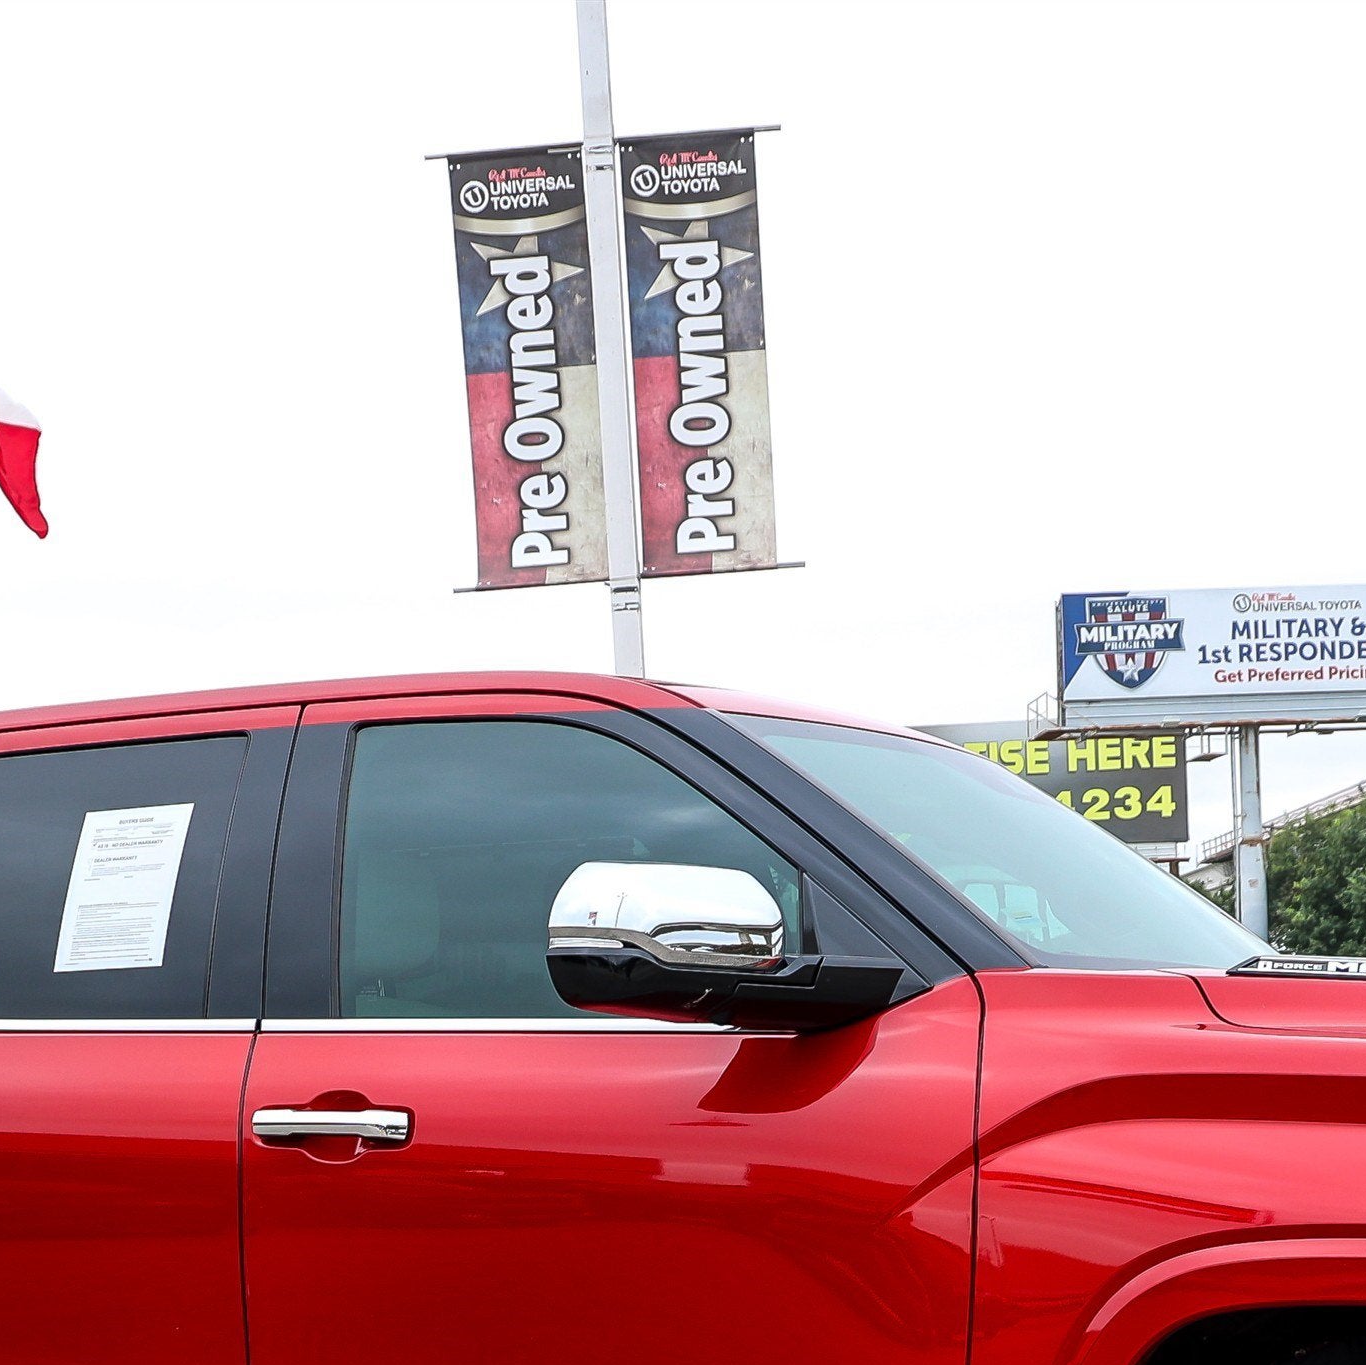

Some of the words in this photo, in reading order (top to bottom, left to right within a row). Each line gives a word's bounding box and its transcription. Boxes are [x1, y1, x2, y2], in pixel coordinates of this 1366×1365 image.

[660, 160, 746, 180] UNIVERSAL
[489, 175, 575, 195] UNIVERSAL
[661, 178, 720, 195] TOYOTA
[490, 192, 549, 211] TOYOTA
[658, 240, 731, 447] Owned
[490, 255, 565, 462] Owned
[676, 456, 736, 554] Pre
[511, 470, 570, 568] Pre
[1107, 603, 1149, 613] SALUTE
[1252, 600, 1317, 612] UNIVERSAL
[1318, 599, 1362, 610] TOYOTA
[1080, 622, 1179, 643] MILITARY
[1231, 616, 1345, 640] MILITARY
[1350, 616, 1366, 636] &
[1198, 644, 1233, 664] 1st
[1214, 668, 1244, 683] Get
[1248, 666, 1324, 682] Preferred
[1067, 735, 1177, 772] HERE
